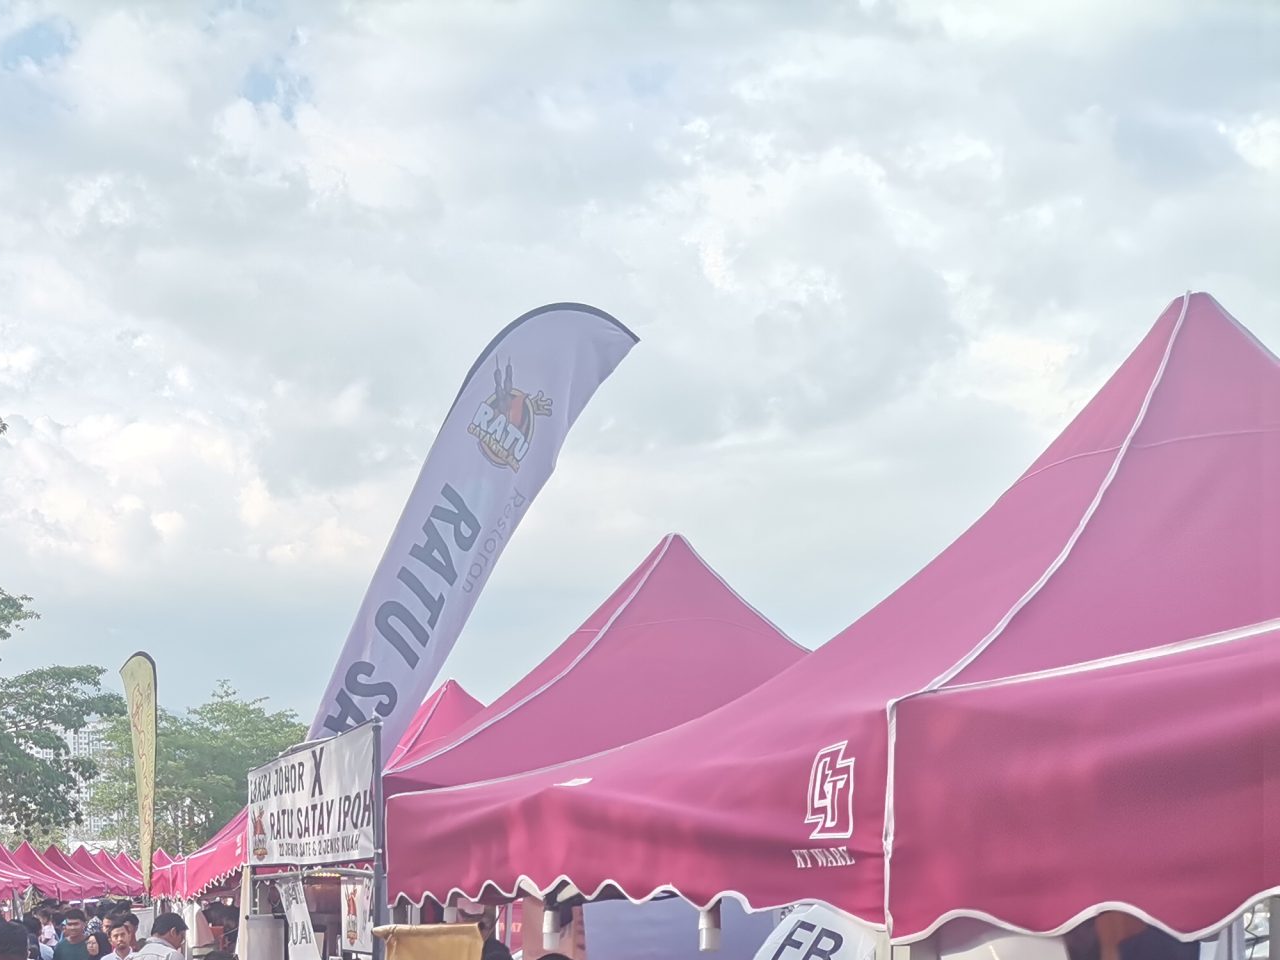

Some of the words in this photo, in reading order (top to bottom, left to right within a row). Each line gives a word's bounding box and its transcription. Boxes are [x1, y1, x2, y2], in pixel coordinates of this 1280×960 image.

[472, 401, 529, 462] RATU
[462, 487, 526, 594] Restoran
[375, 483, 482, 670] RATU
[250, 772, 271, 804] LAKSA
[273, 761, 304, 797] JOHOR
[311, 746, 324, 798] X
[270, 808, 294, 840] RATU
[297, 799, 334, 839] SATAY
[337, 789, 372, 833] IPOH
[792, 849, 812, 868] KT
[810, 846, 855, 868] WARE
